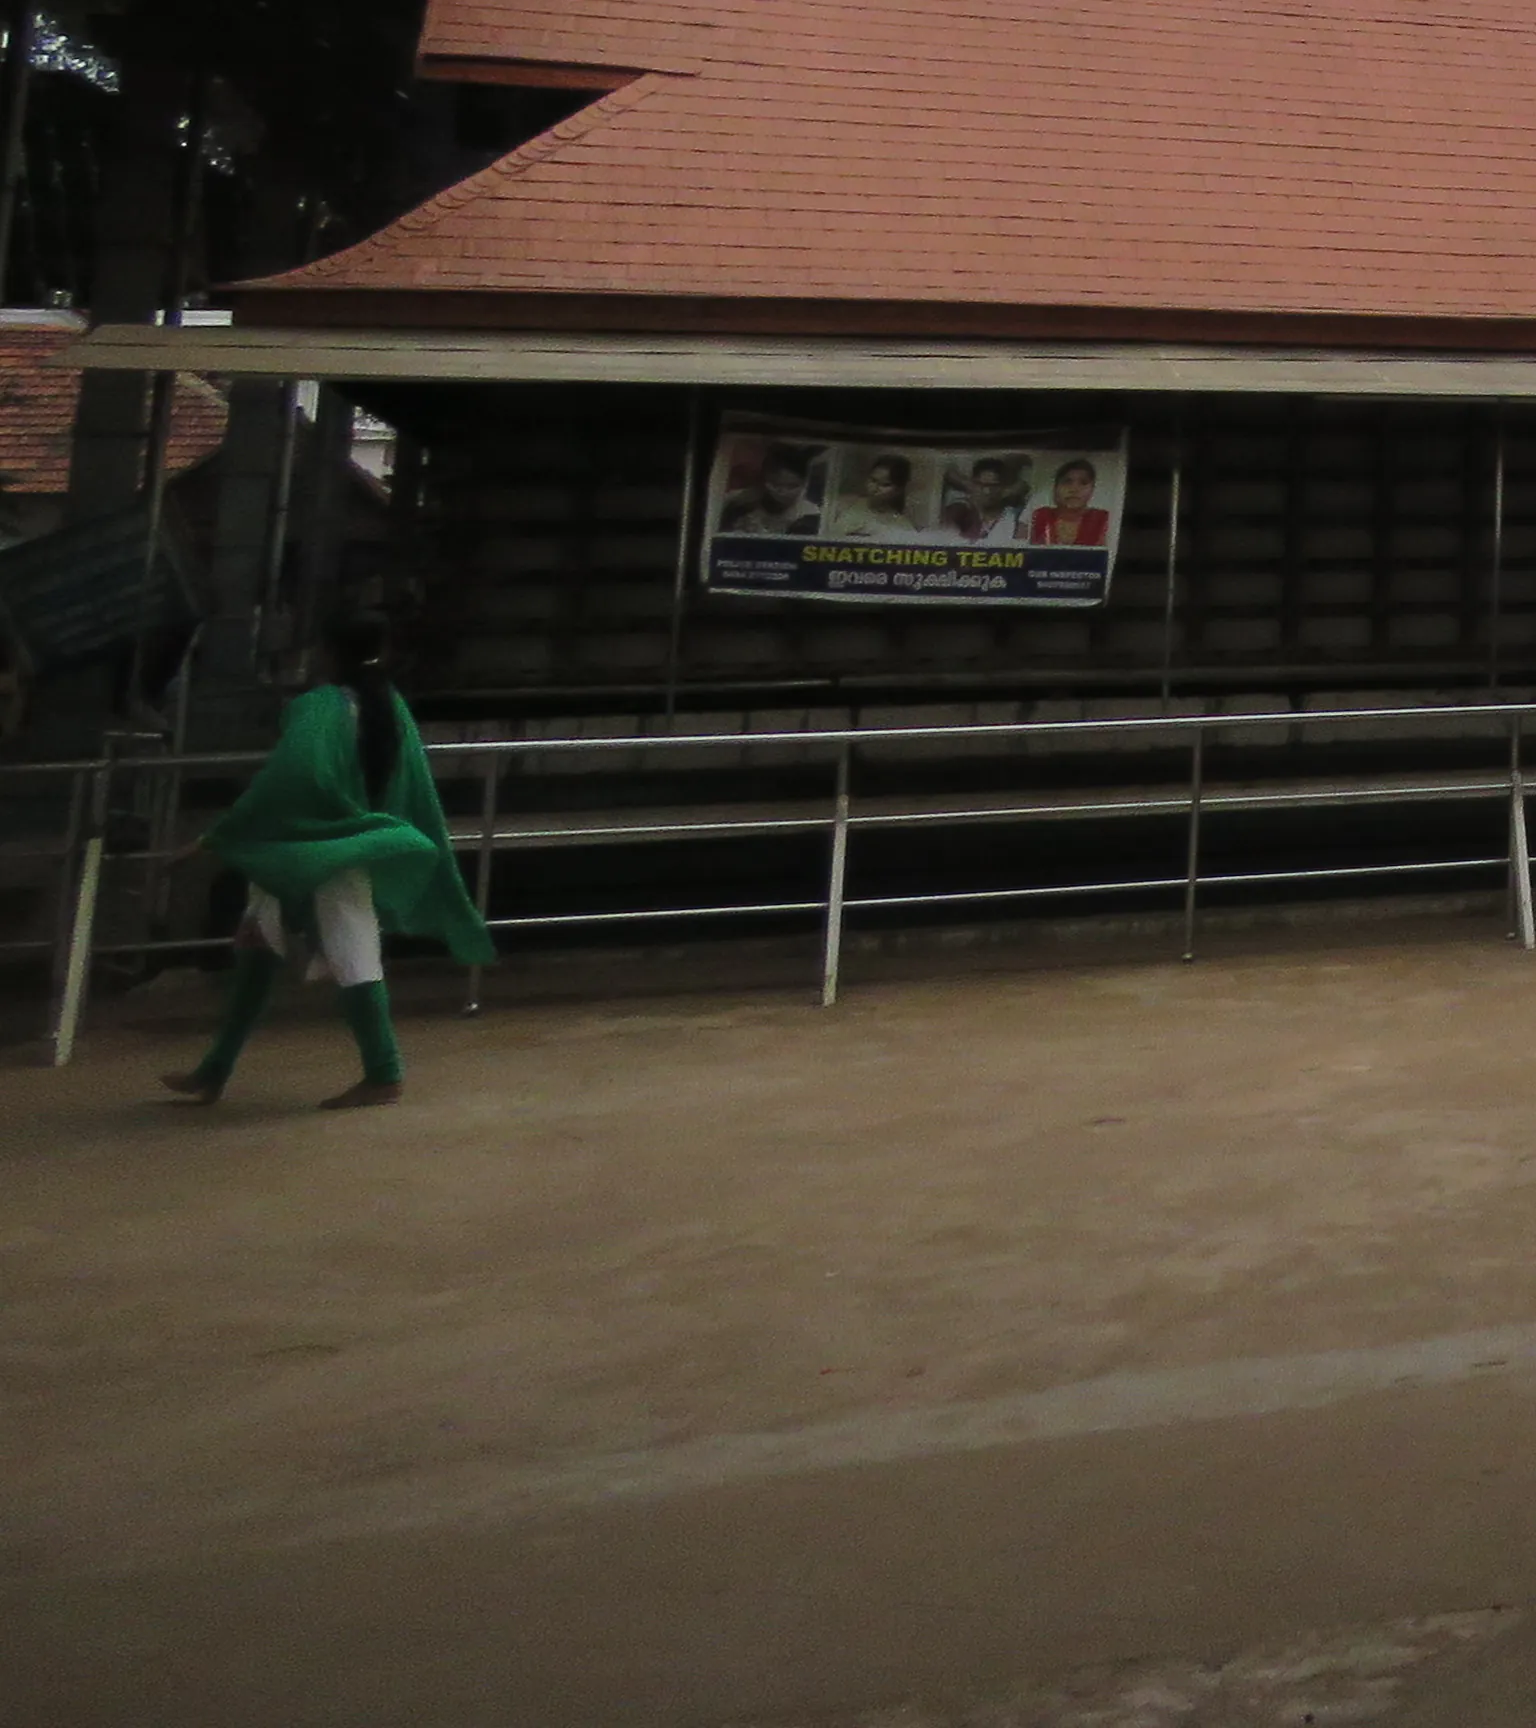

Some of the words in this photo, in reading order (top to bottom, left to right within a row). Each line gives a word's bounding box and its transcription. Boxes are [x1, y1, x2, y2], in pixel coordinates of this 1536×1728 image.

[802, 545, 948, 566] SNATCHING
[956, 551, 1024, 569] TEAM
[828, 569, 888, 589] ഇവരെ
